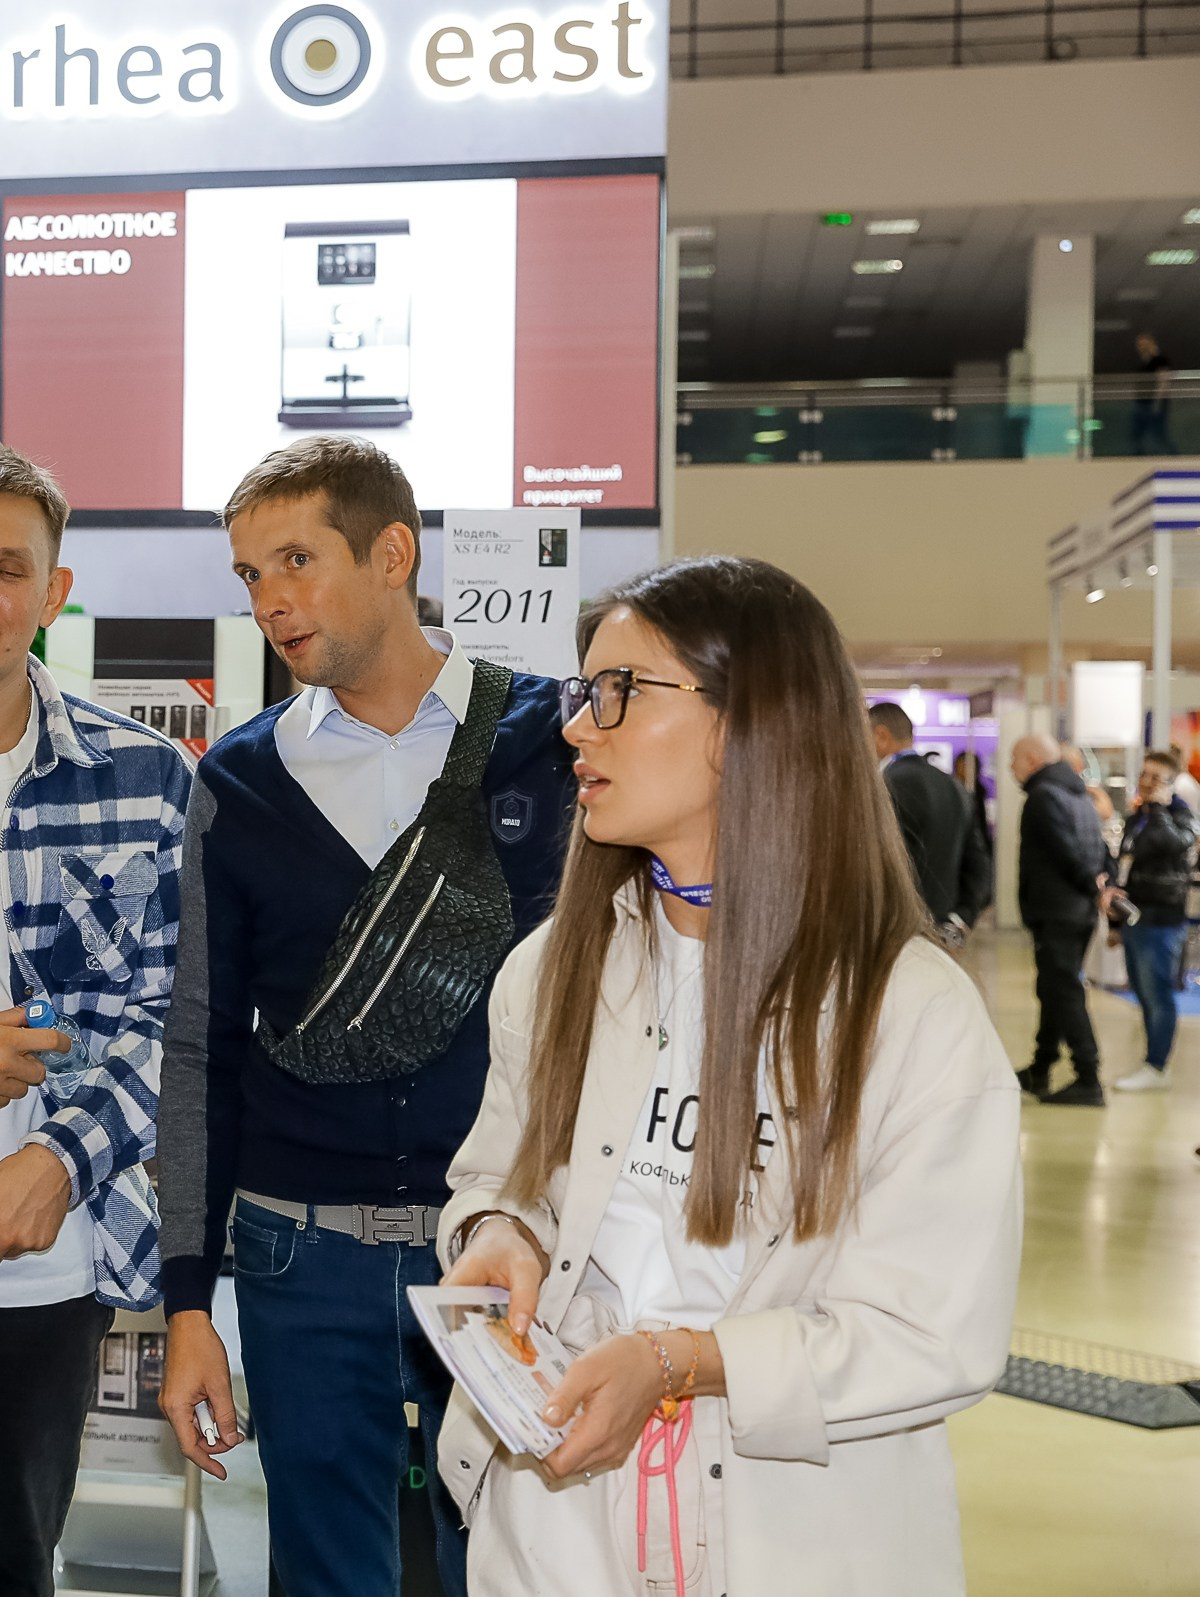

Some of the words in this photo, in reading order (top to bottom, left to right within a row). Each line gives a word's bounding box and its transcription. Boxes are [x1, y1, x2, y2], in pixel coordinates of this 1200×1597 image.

[12, 24, 224, 107] rhea
[425, 1, 644, 87] east
[4, 211, 177, 241] АБСОЛЮТНОЕ
[5, 249, 132, 276] КАЧЕСТВО
[453, 588, 553, 624] 2011
